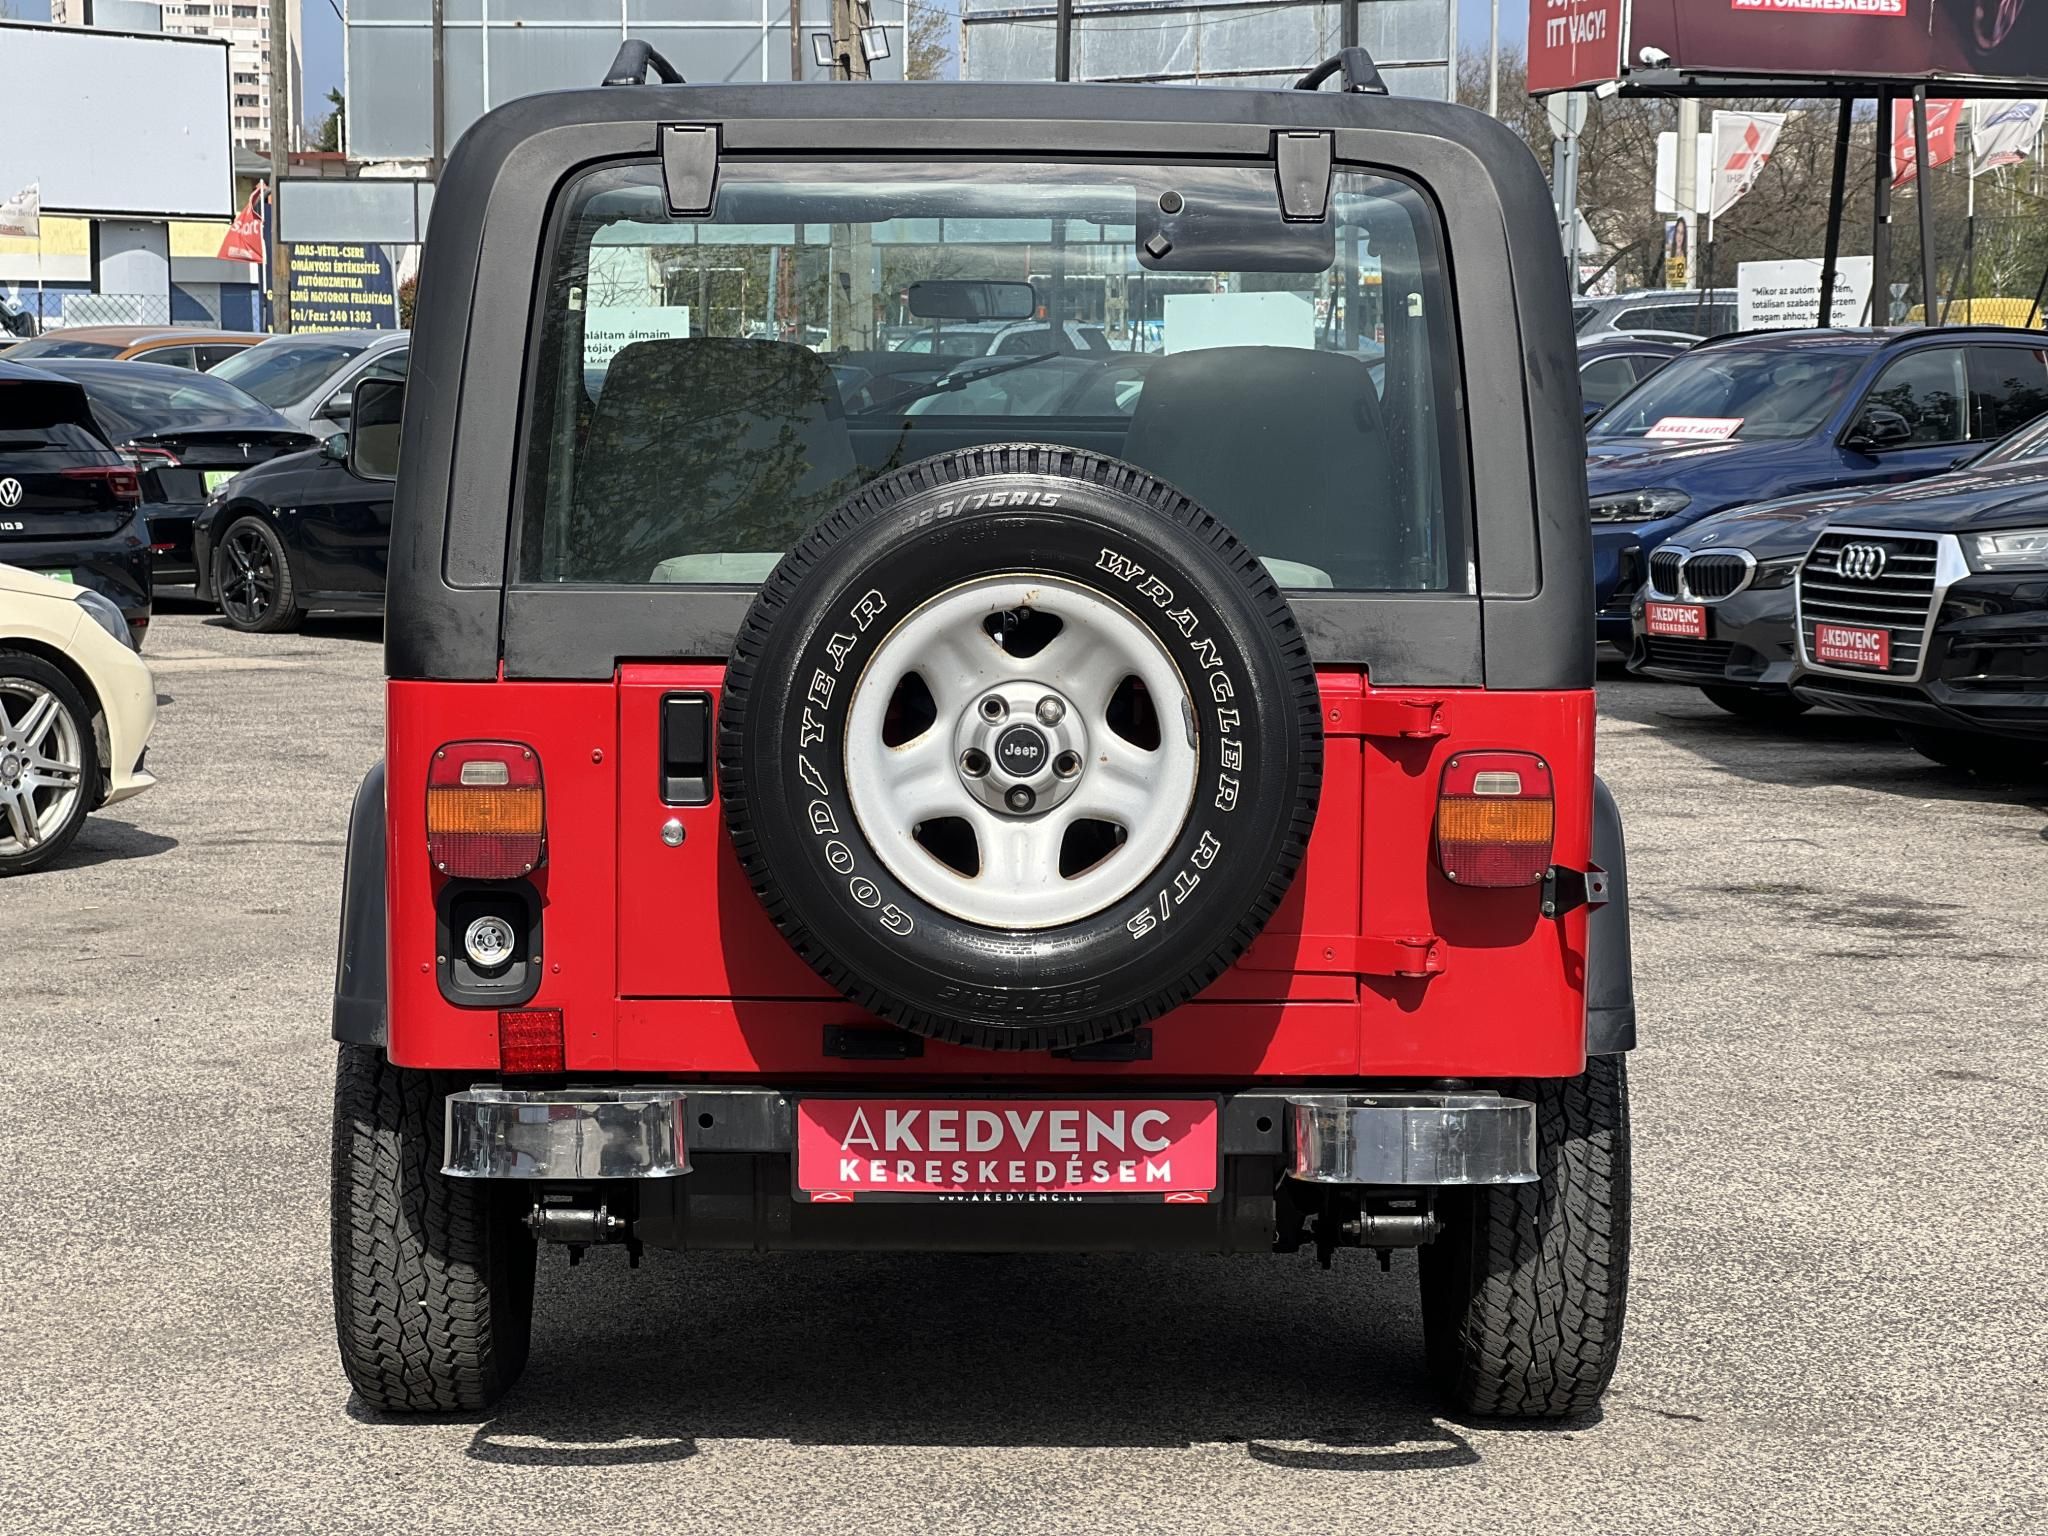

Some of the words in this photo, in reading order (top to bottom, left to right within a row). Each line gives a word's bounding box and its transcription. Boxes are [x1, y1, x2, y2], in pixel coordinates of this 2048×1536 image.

[1546, 17, 1567, 48] ITT
[1568, 9, 1607, 43] VAGY!
[291, 258, 332, 273] OMÁNYOSI
[297, 273, 363, 289] AUTÓKOZMETIKA
[310, 291, 349, 304] MOTOROK
[1790, 285, 1815, 295] autóm
[1752, 298, 1785, 309] totálisan
[1786, 297, 1820, 308] szabadn
[290, 308, 329, 322] Tel/Fax:
[330, 310, 348, 322] 240
[349, 310, 372, 323] 1303
[1752, 314, 1780, 323] magam
[1782, 311, 1808, 321] ahhoz,
[627, 328, 671, 339] álmaim
[900, 491, 1063, 536] 225/75R15
[1650, 605, 1699, 623] AKEDVENC
[1650, 621, 1700, 634] KERESKEDÉSEM
[1821, 629, 1880, 650] AKEDVENC
[1821, 646, 1881, 663] KERESKEDÉSEM
[1095, 548, 1243, 812] WRANGLER
[1004, 743, 1039, 759] Jeep
[1126, 830, 1222, 940] RT/S
[840, 1105, 1172, 1152] AKEDVENC
[839, 1153, 1172, 1184] KERESKEDÉSEM
[938, 1192, 1084, 1203] www.AKEDVENC.hu
